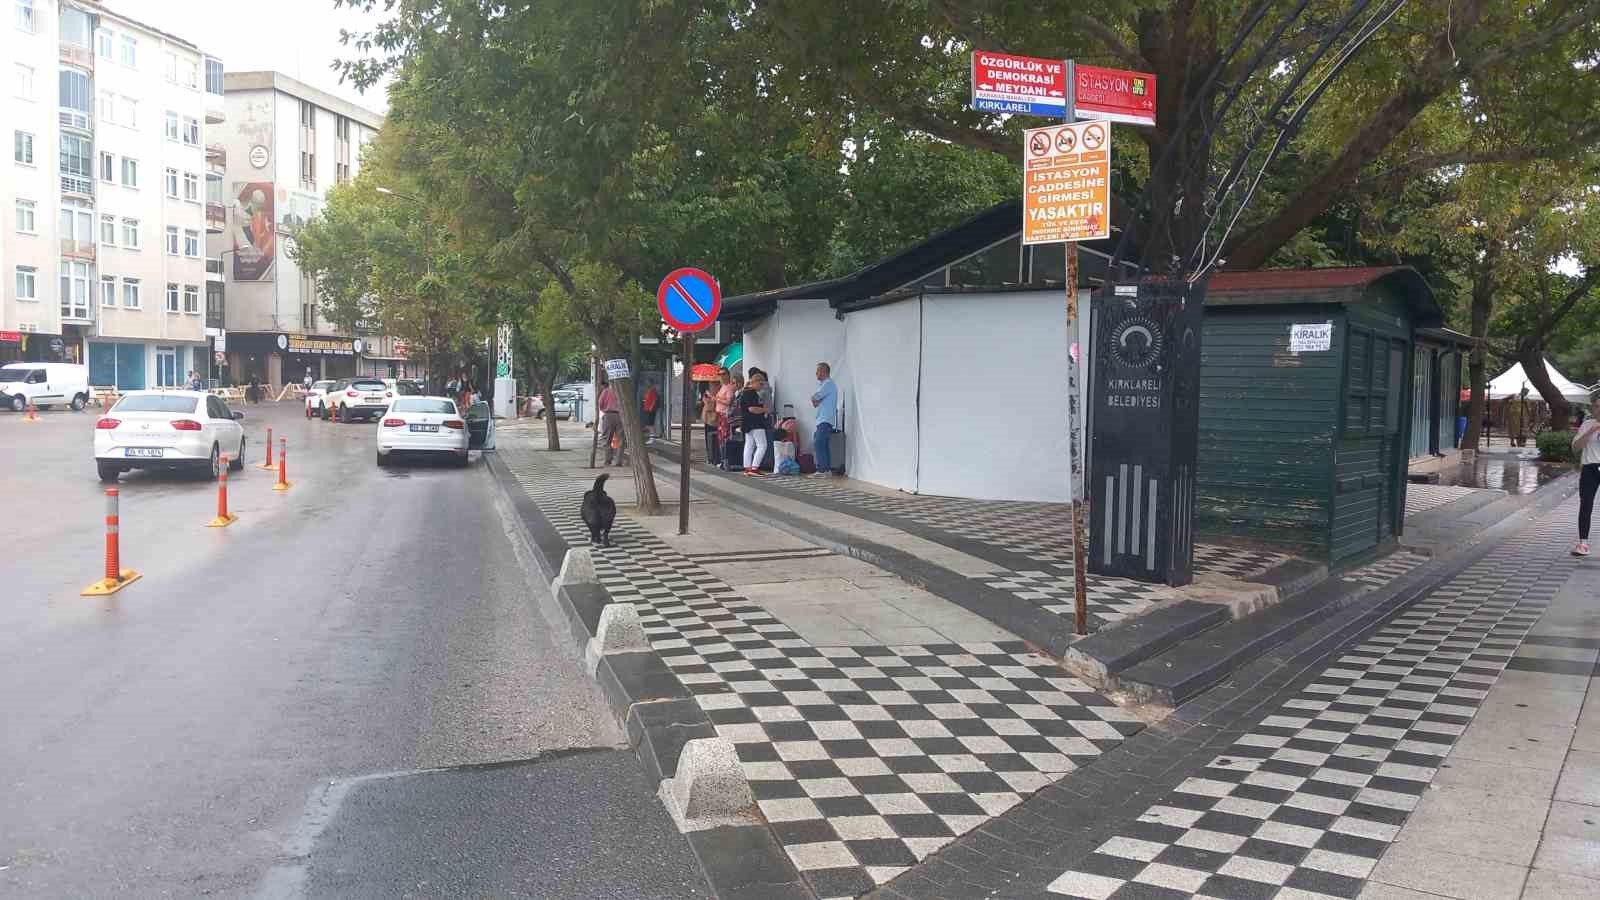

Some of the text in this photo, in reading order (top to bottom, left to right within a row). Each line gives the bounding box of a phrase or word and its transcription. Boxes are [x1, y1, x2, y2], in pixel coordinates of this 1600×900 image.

[980, 55, 1061, 74] ÖZGÜRLÜK VE
[988, 70, 1054, 85] DEMOKRASİ
[1078, 71, 1129, 93] İSTASYON
[996, 83, 1047, 96] MEYDANI
[979, 101, 1031, 113] KIRKLARELİ
[1034, 167, 1099, 182] İSTASYON
[1029, 178, 1105, 193] CADDESİNE
[1030, 203, 1104, 220] YASAKTIR
[1108, 394, 1161, 409] BELEDİYESİ
